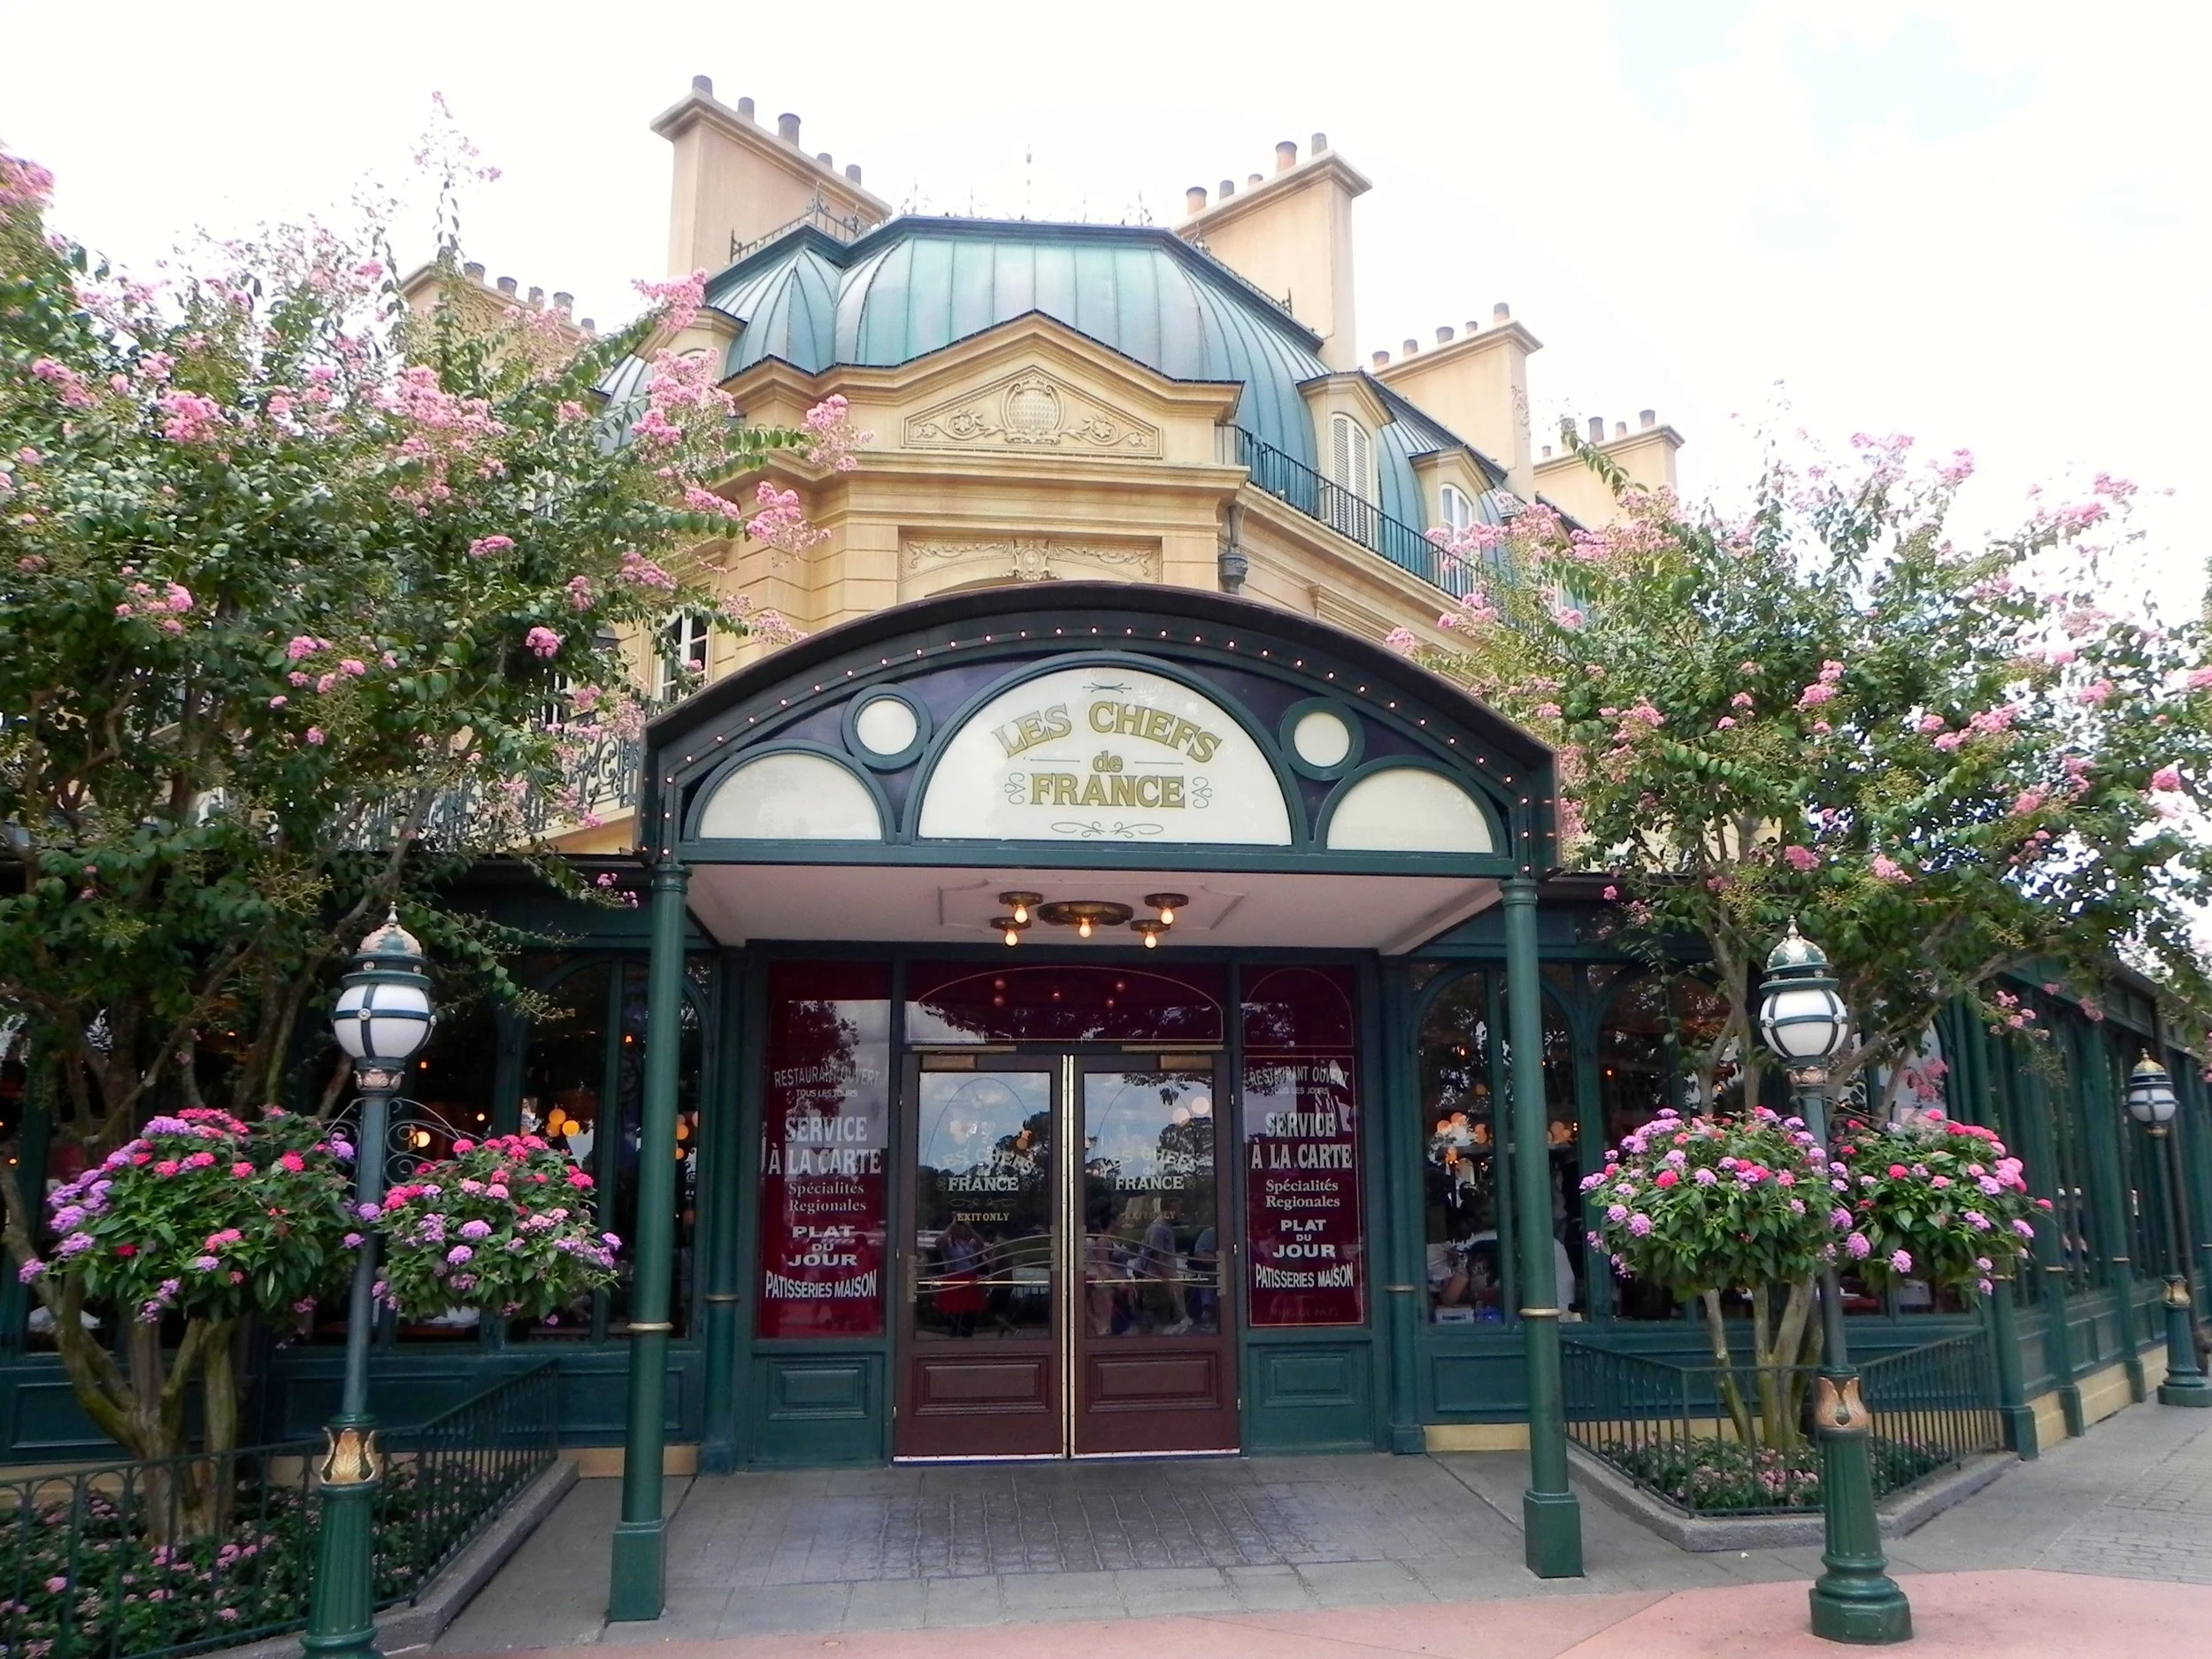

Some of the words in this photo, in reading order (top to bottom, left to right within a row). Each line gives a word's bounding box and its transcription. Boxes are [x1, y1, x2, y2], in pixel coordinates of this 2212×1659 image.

[992, 703, 1072, 759] LES
[1088, 700, 1223, 763] CHEFS
[1093, 750, 1123, 772] de
[1029, 772, 1186, 809] FRANCE
[774, 1065, 841, 1088] RESTAURANT
[841, 1066, 880, 1087] OUVERT
[785, 1116, 868, 1141] SERVICE
[1265, 1112, 1336, 1137] SERVICE
[768, 1142, 781, 1174] À
[787, 1149, 812, 1174] LA
[818, 1148, 881, 1175] CARTE
[1251, 1137, 1263, 1168] À
[1270, 1144, 1292, 1168] LA
[1297, 1143, 1353, 1169] CARTE
[788, 1182, 864, 1197] Spécialités
[948, 1177, 1019, 1192] FRANCE
[1115, 1175, 1185, 1190] FRANCE
[1265, 1179, 1339, 1194] Spécialités
[788, 1199, 867, 1215] Regionales
[1265, 1195, 1340, 1210] Regionales
[792, 1225, 856, 1238] PLAT
[1280, 1219, 1326, 1232] PLAT
[811, 1243, 834, 1252] DU
[1272, 1244, 1336, 1258] JOUR
[787, 1254, 857, 1267] JOUR
[1256, 1263, 1315, 1288] PATISSERIES
[1317, 1262, 1354, 1288] MAISON
[765, 1269, 833, 1299] PATISSERIES
[834, 1269, 877, 1298] MAISON
